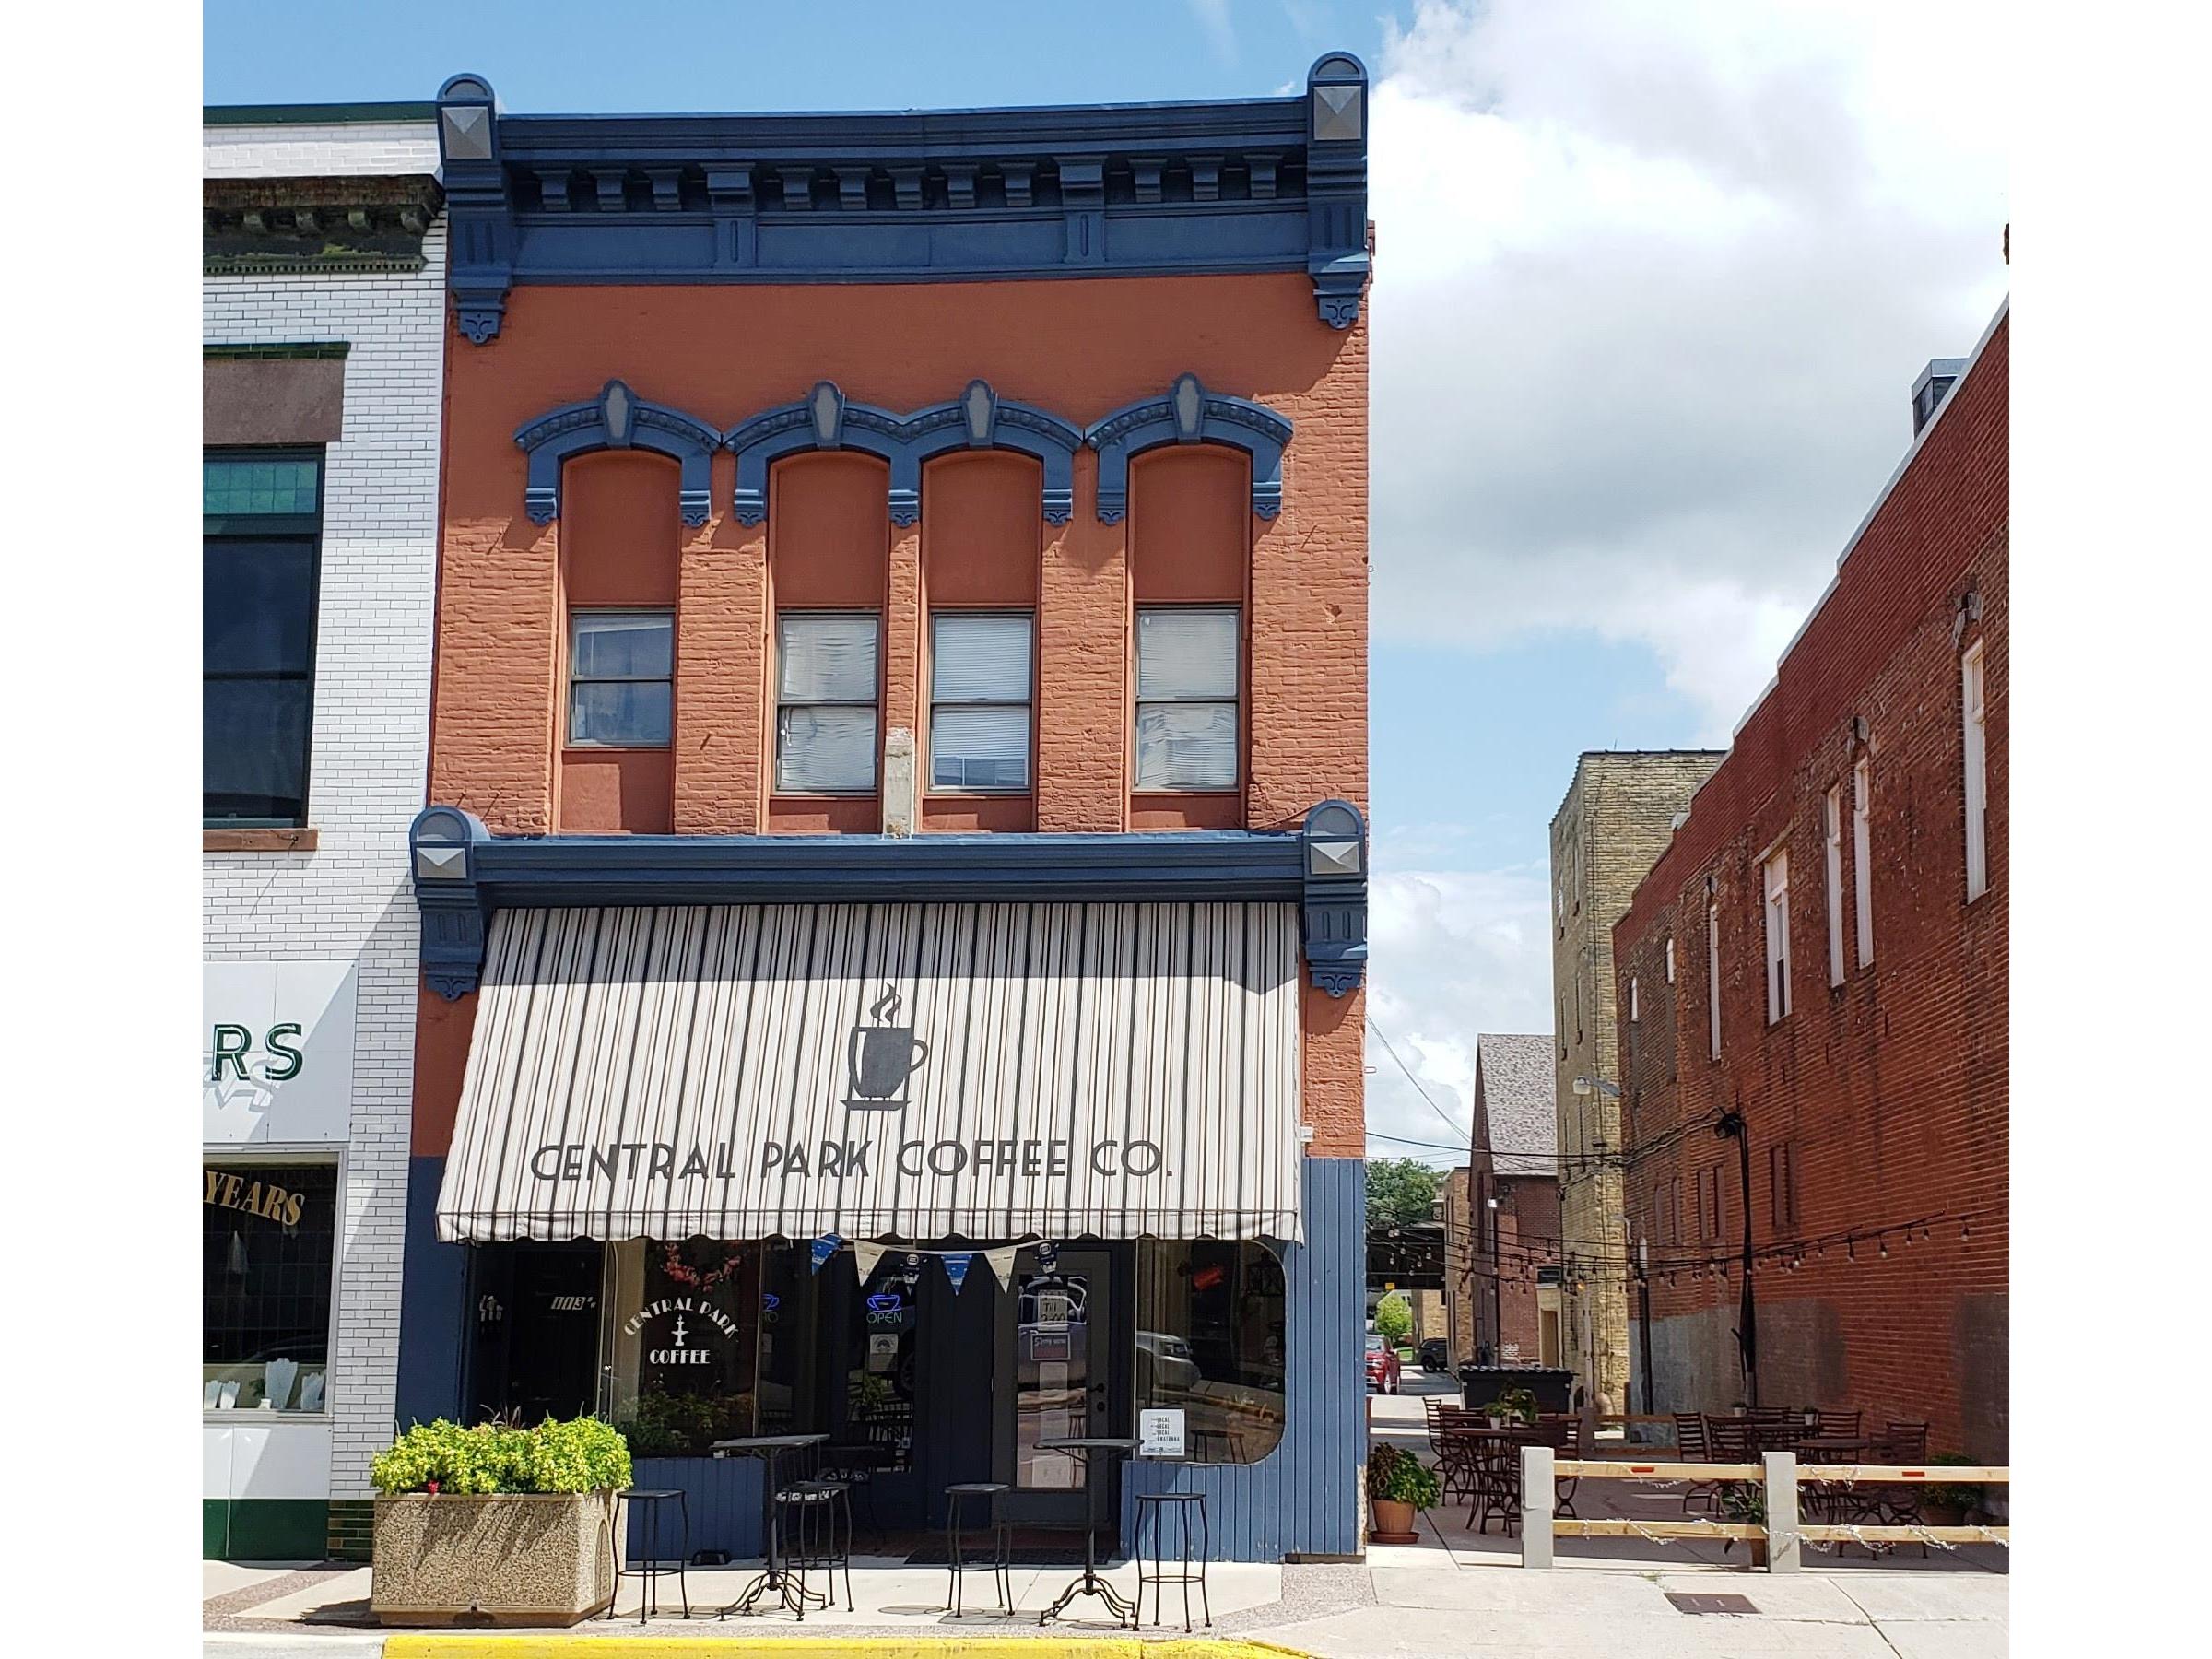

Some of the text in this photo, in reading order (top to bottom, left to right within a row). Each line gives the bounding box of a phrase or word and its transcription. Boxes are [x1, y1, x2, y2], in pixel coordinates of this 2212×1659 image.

[211, 1023, 304, 1081] RS
[530, 1139, 1173, 1181] CENTRAL PARK COFFEE CO.
[203, 1170, 305, 1227] YEARS
[624, 1297, 739, 1339] CENTRAL PARK
[866, 1312, 902, 1324] OPEN
[649, 1349, 711, 1364] COFFEE
